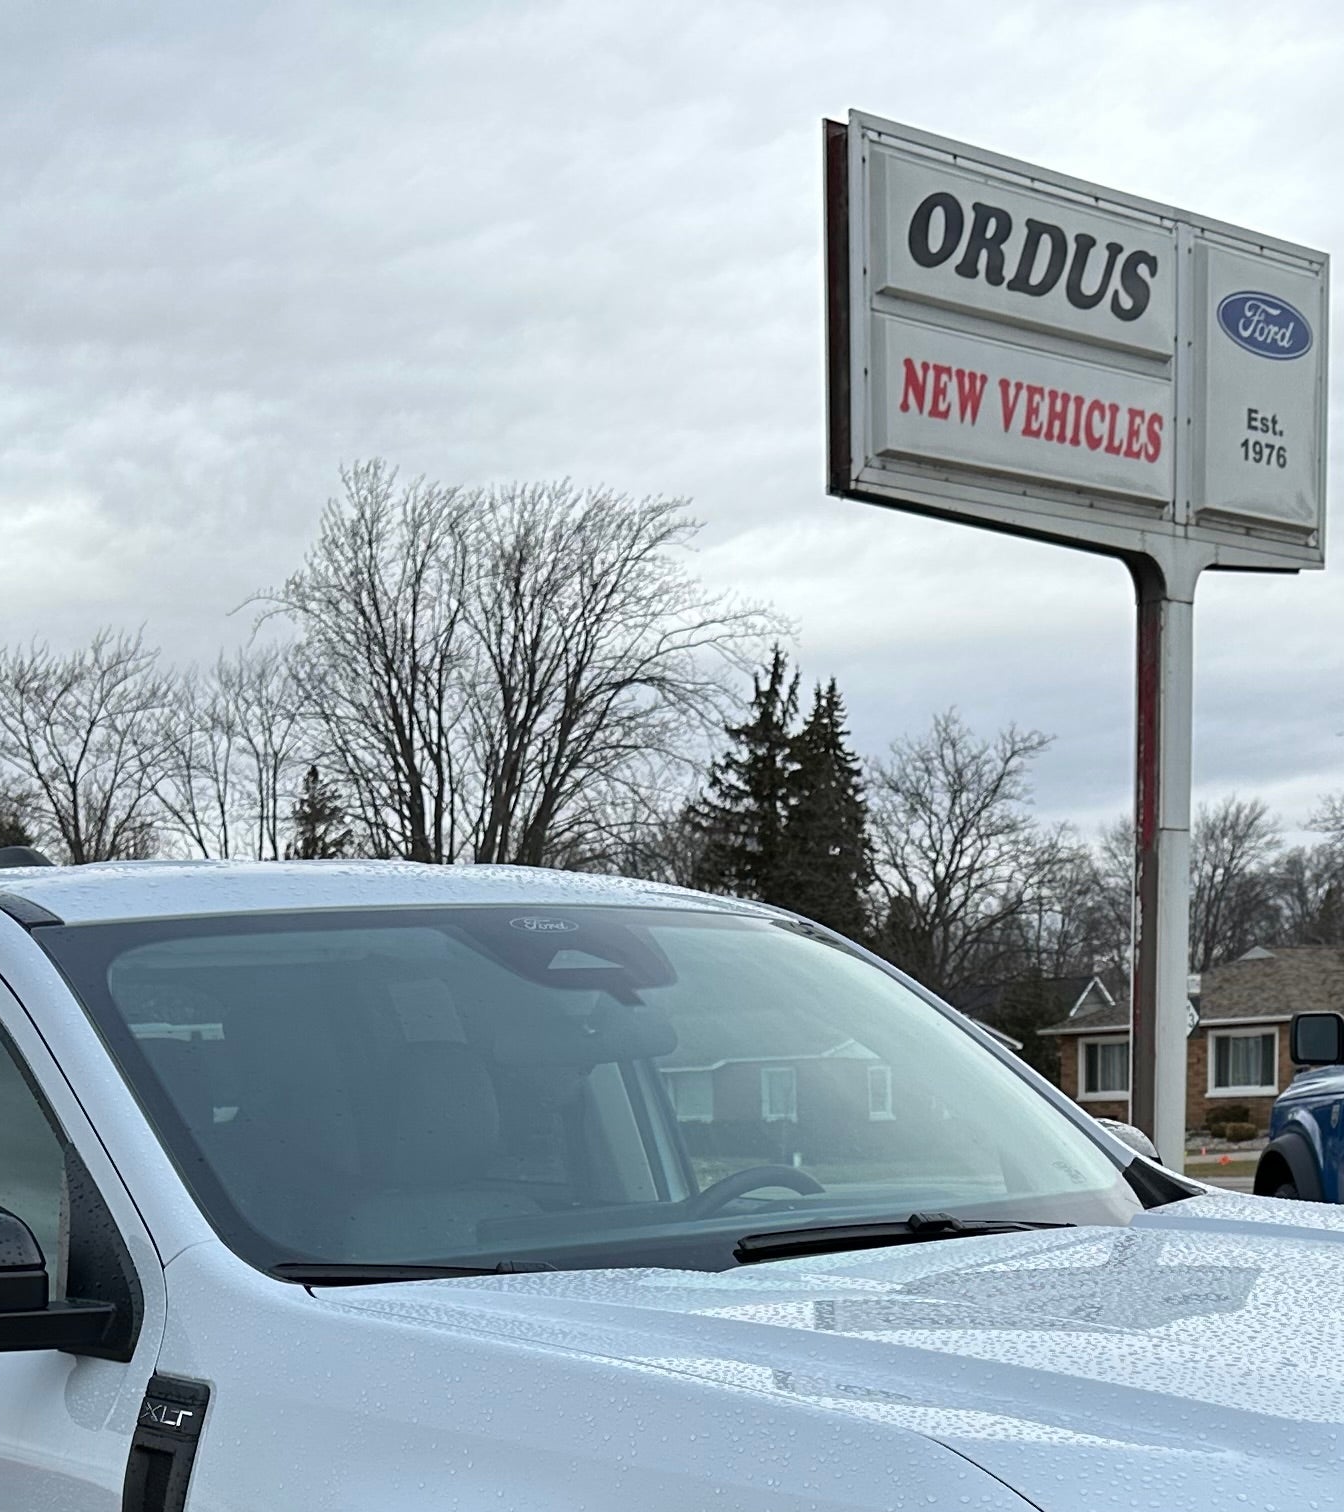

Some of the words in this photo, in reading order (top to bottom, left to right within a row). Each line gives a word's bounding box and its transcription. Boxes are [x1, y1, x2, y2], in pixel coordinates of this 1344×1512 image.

[908, 192, 1158, 322] ORDUS
[1238, 300, 1295, 348] Ford
[900, 358, 988, 426] NEW
[998, 379, 1164, 463] VEHICLES
[1247, 408, 1284, 437] Est.
[1240, 437, 1288, 469] 1976
[523, 918, 568, 930] Ford
[140, 1401, 193, 1427] XLT
